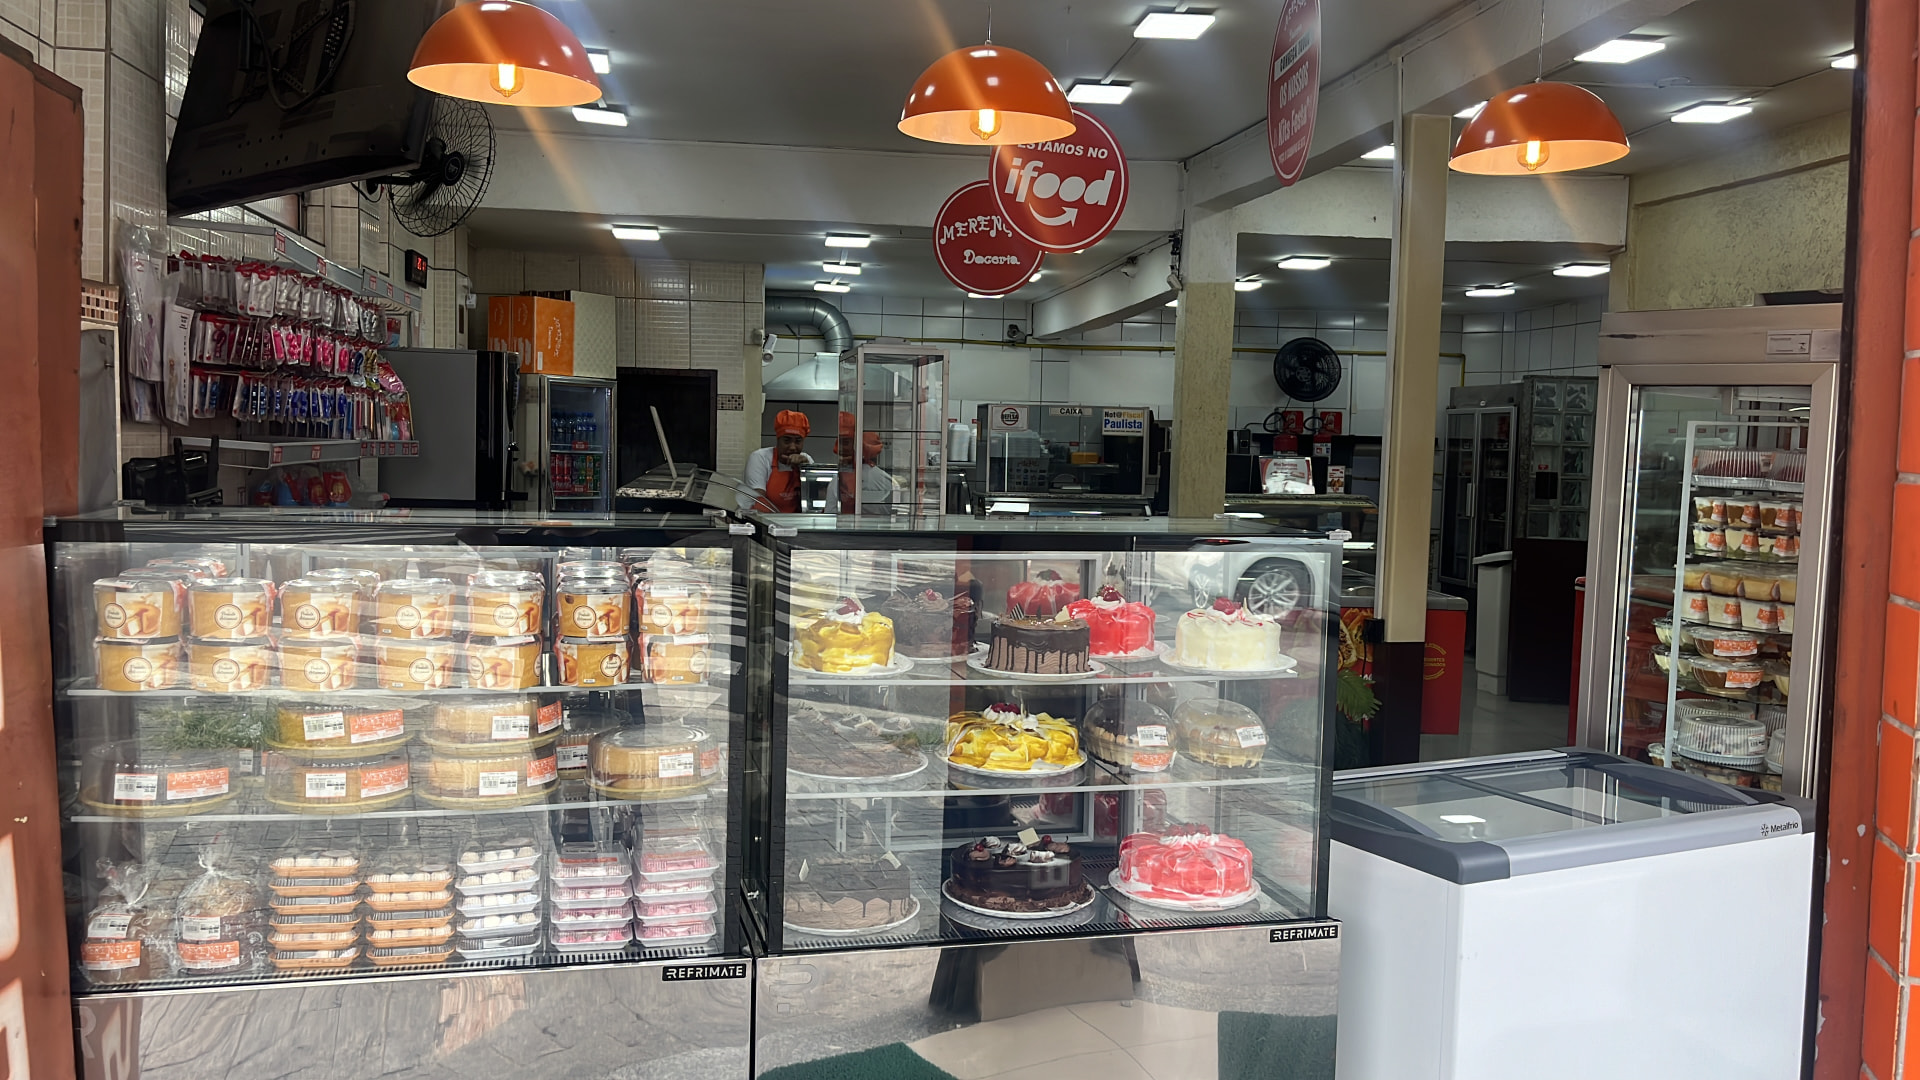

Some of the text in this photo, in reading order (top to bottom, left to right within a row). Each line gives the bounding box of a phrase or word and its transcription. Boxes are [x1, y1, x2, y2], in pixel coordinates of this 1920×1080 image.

[1279, 84, 1288, 109] OS
[1278, 116, 1291, 146] Kits
[1087, 147, 1108, 159] NO
[1004, 157, 1115, 206] ifood
[1060, 407, 1083, 415] CAIXA
[1104, 419, 1142, 429] Paulista
[1770, 821, 1799, 832] Metalfrio
[1273, 926, 1336, 940] REFRIMATE
[666, 965, 743, 979] REFRIMATE
